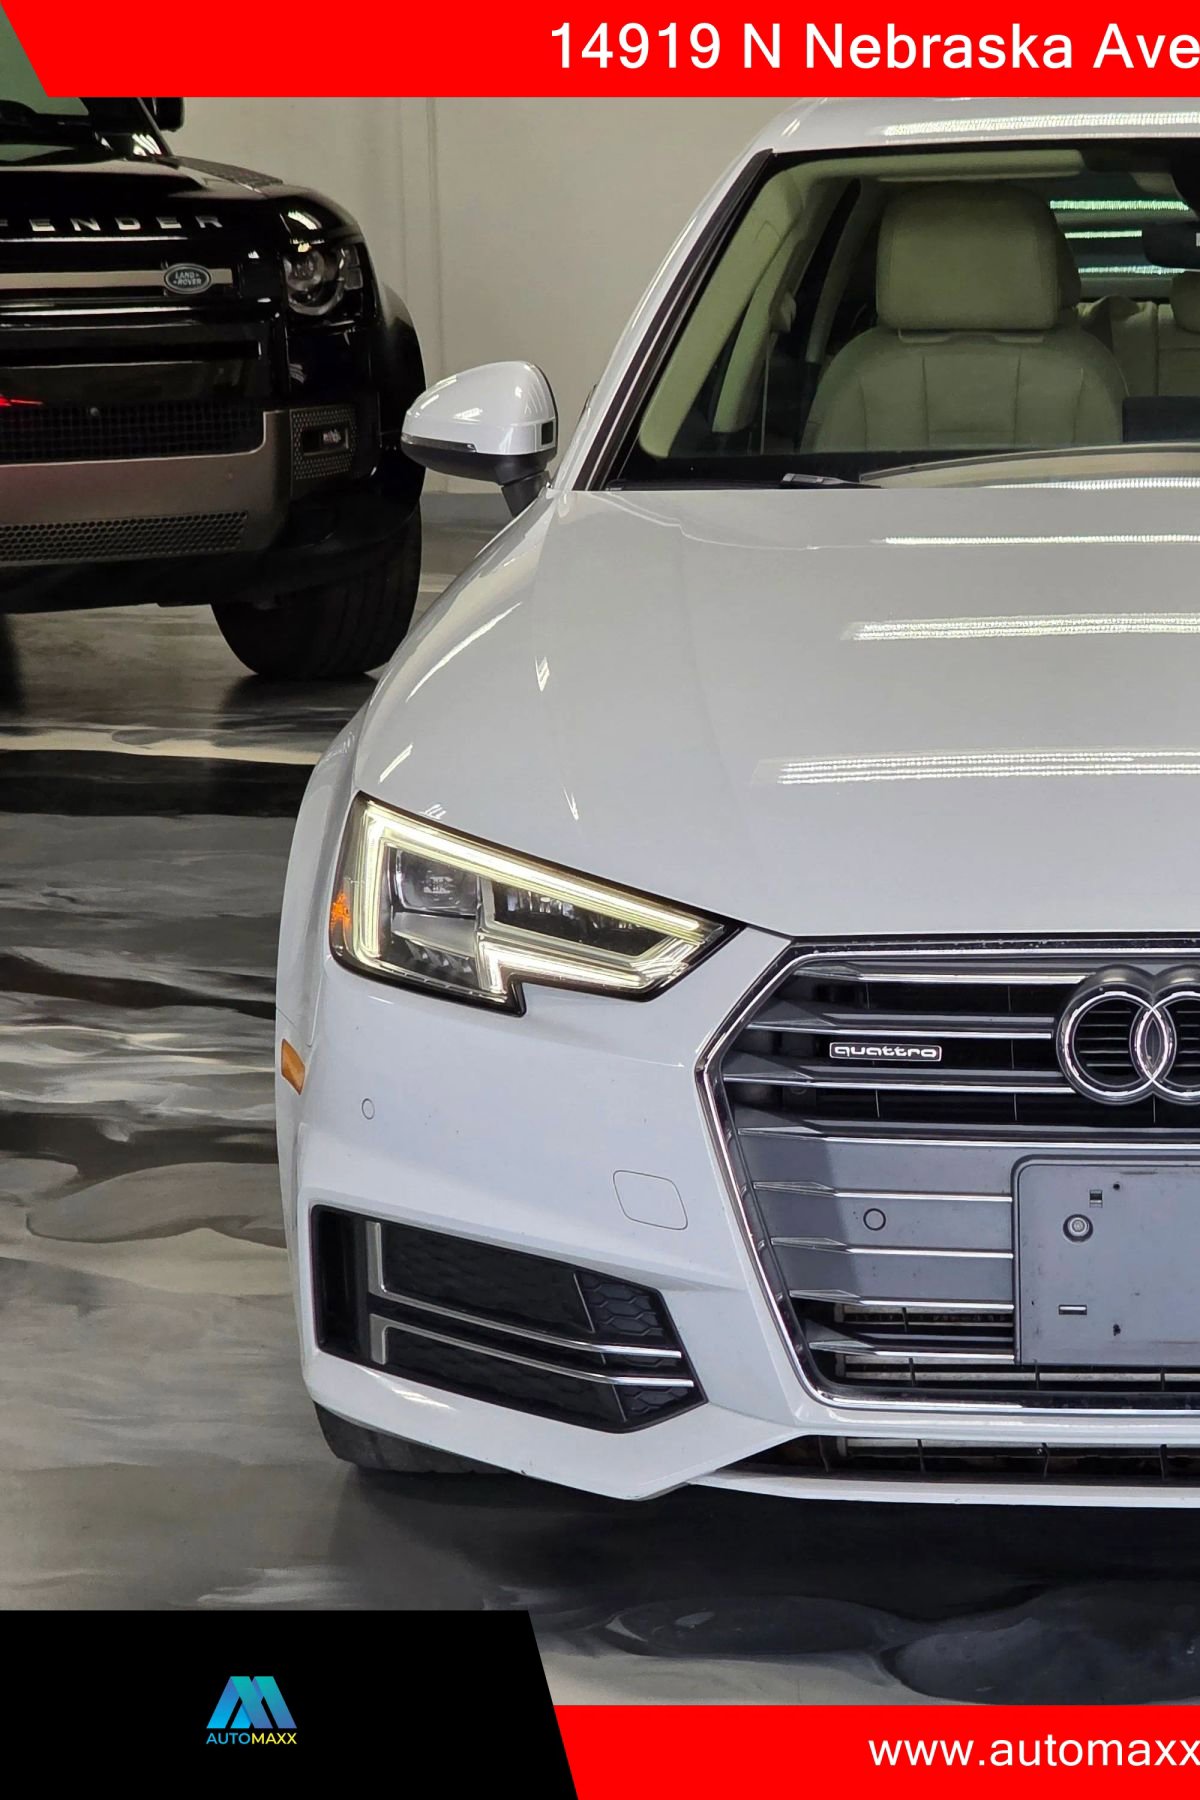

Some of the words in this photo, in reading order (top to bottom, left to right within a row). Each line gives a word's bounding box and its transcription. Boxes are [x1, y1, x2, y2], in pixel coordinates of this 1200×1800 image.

[175, 271, 195, 279] LAND
[177, 278, 202, 286] ROVER
[834, 1045, 938, 1058] quattro
